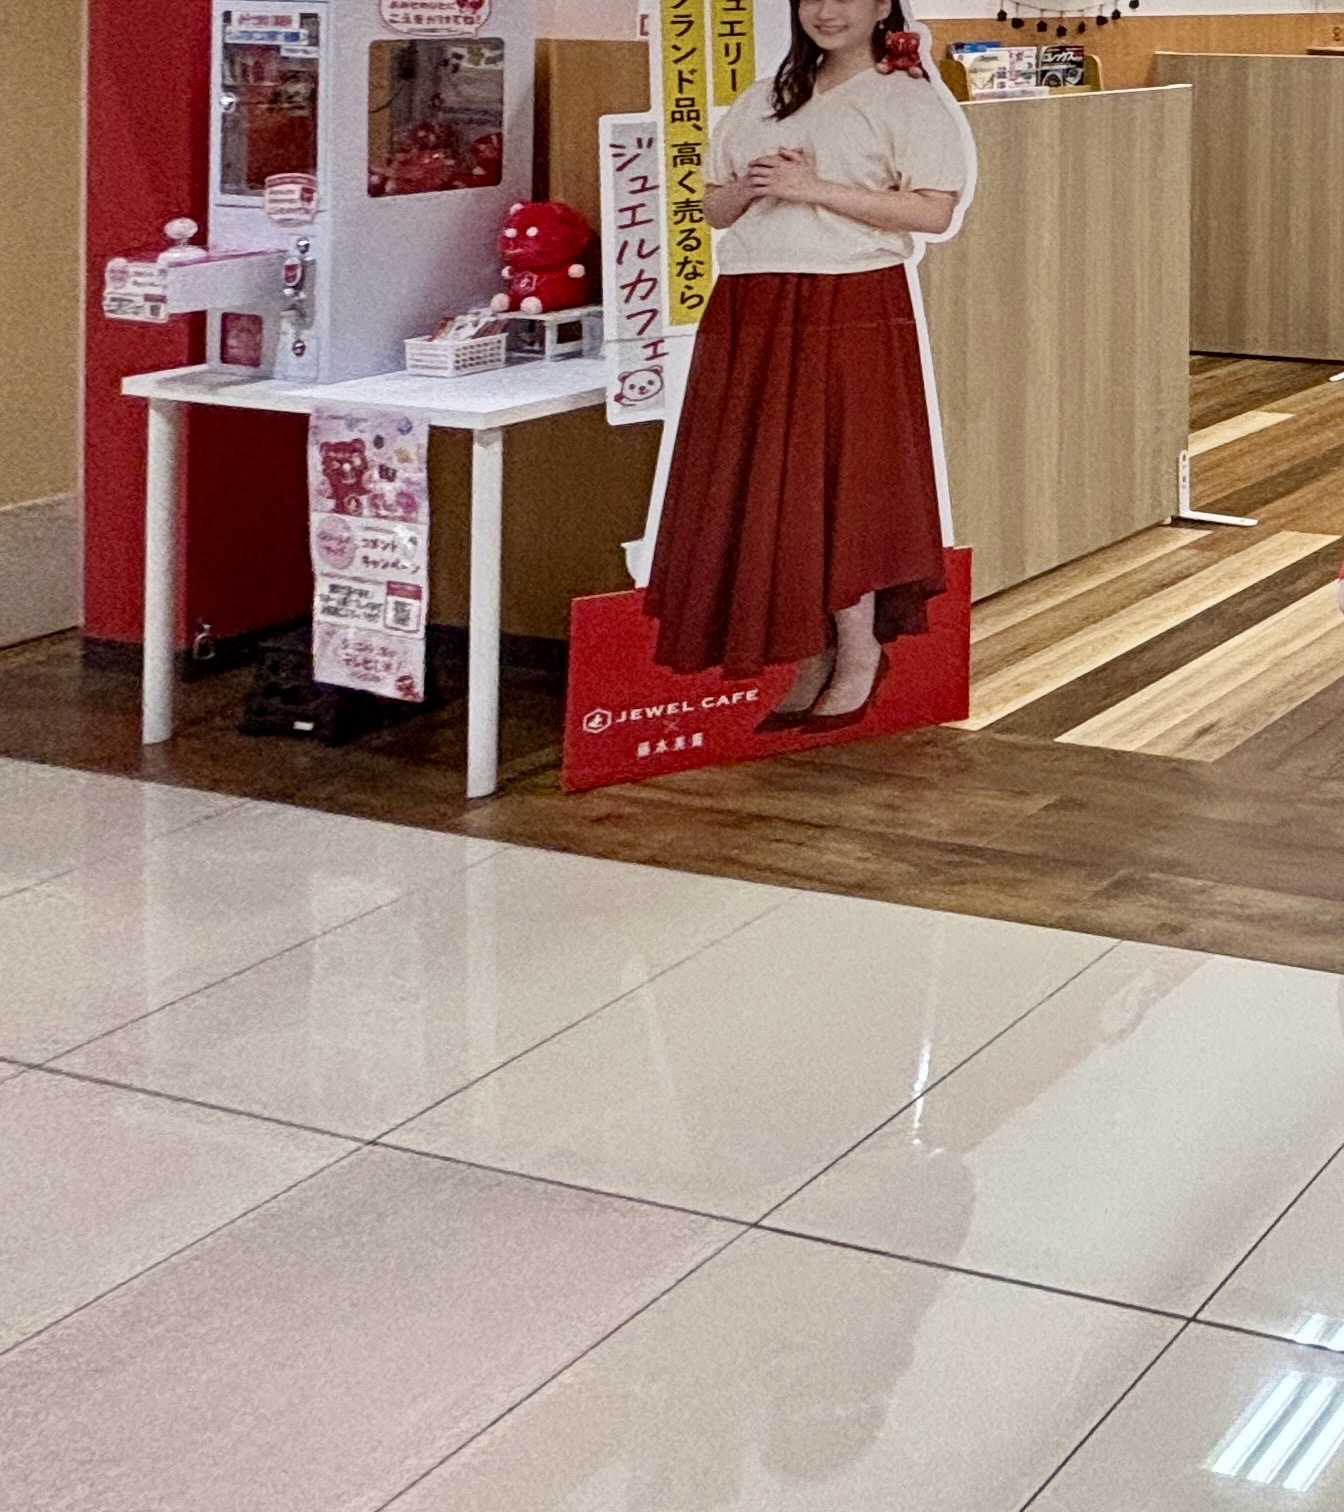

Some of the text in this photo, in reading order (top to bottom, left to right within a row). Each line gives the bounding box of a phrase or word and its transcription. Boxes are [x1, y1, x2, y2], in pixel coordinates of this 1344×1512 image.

[609, 137, 669, 361] ジュエルカフェ
[616, 688, 759, 723] JEWEL CAFE
